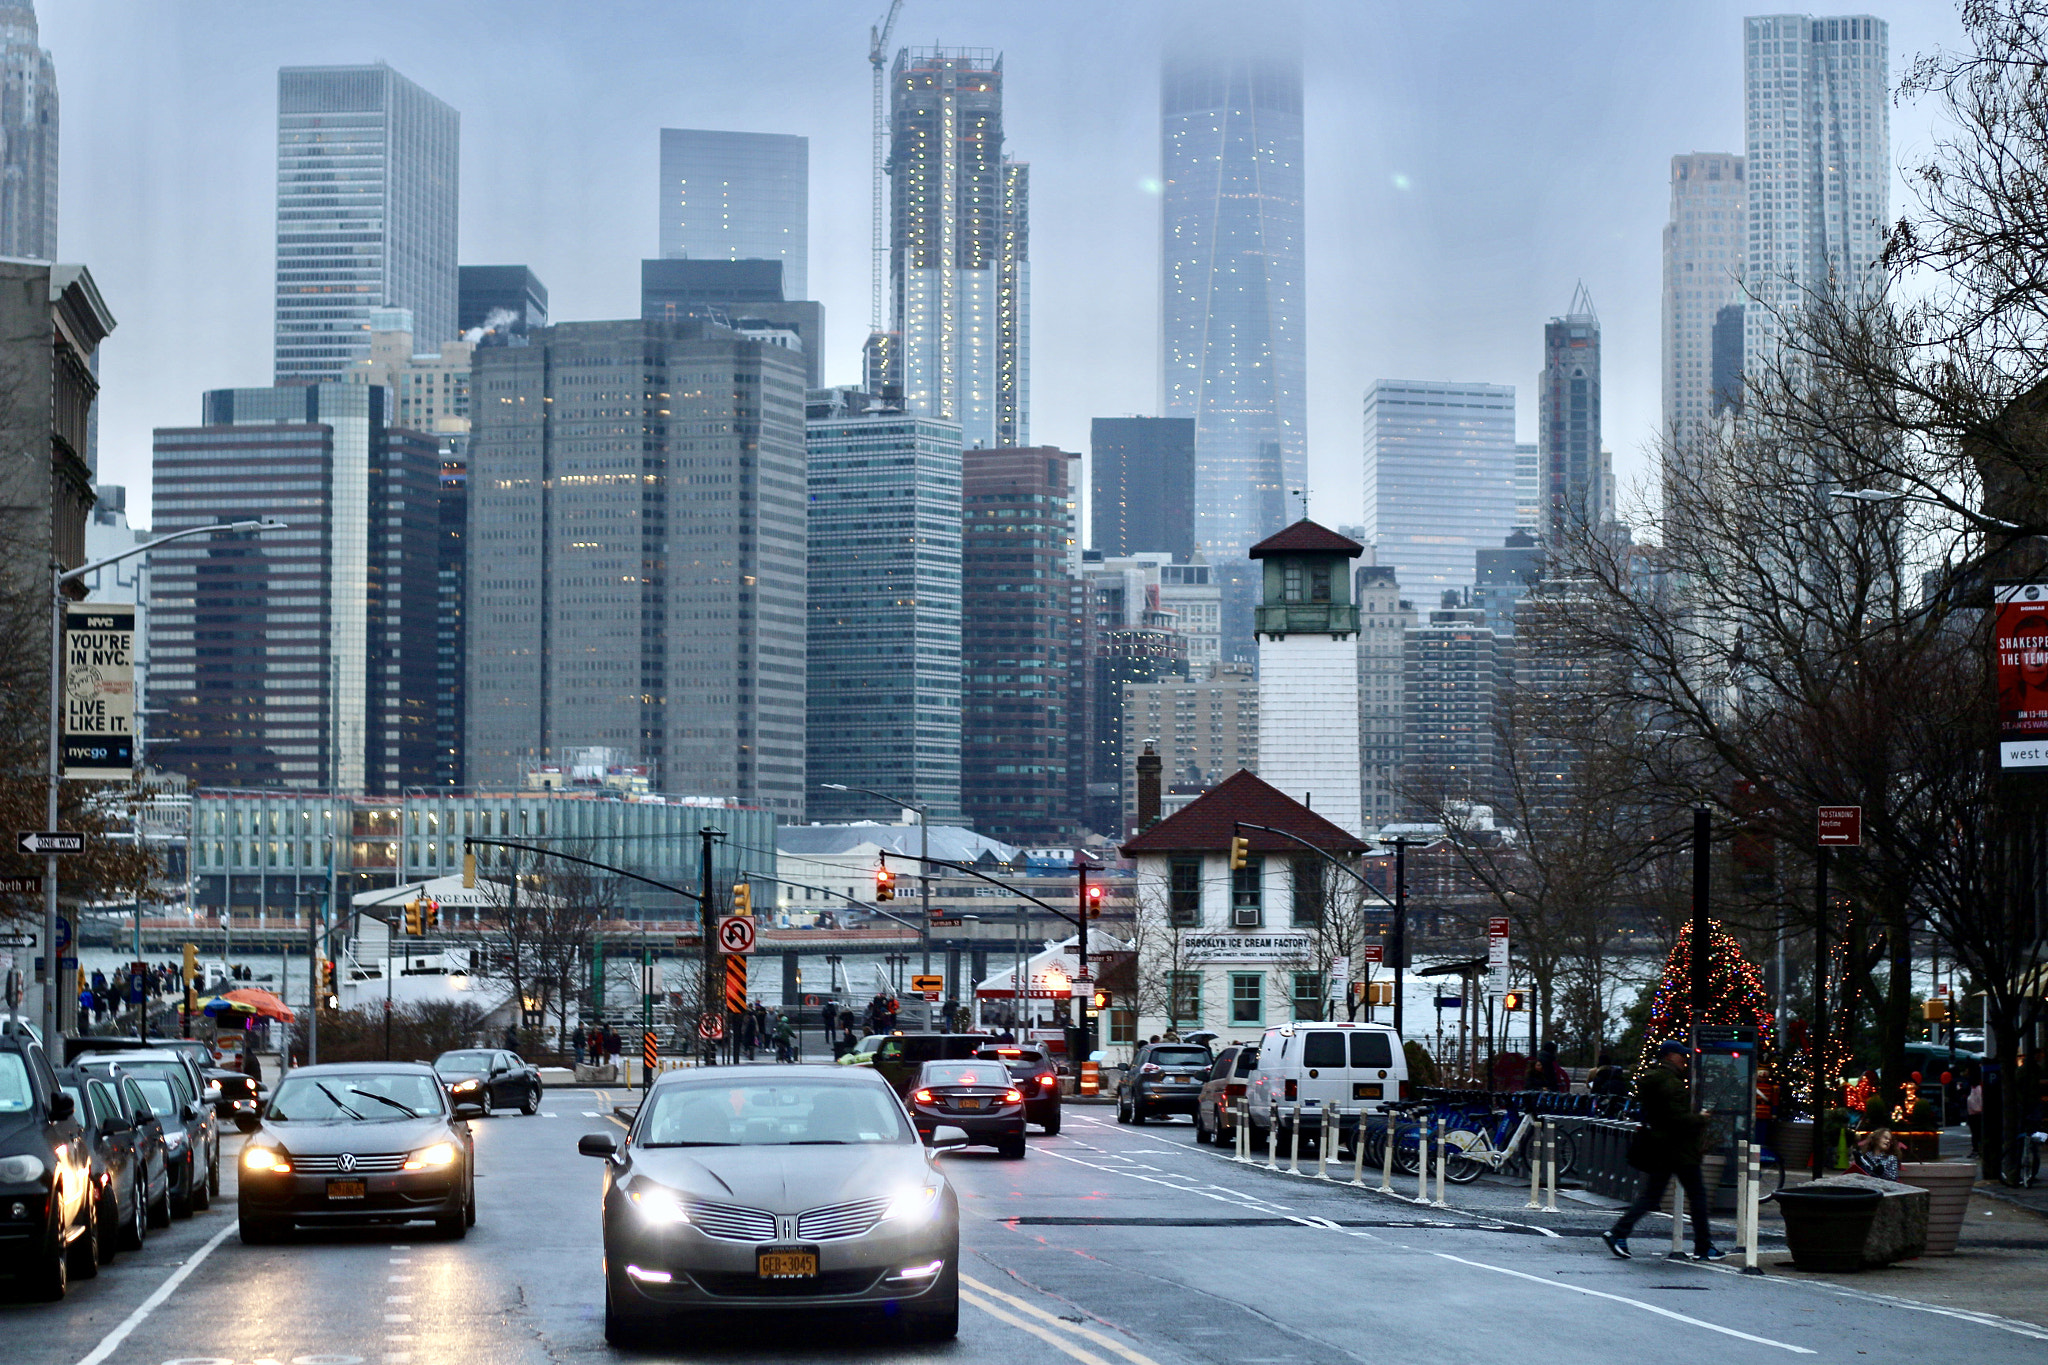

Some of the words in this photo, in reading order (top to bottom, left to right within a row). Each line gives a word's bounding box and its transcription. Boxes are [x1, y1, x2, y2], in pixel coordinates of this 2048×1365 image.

[87, 616, 114, 627] NYC
[70, 633, 131, 650] YOU'RE
[70, 650, 87, 666] IN
[92, 650, 130, 666] NYC.
[2001, 653, 2020, 666] THE
[69, 699, 106, 716] LIVE
[69, 716, 106, 732] LIKE
[110, 716, 128, 732] IT.
[68, 746, 108, 760] nycgo
[2010, 748, 2040, 760] west
[1820, 810, 1829, 818] NO
[1829, 810, 1854, 818] STANDING
[37, 838, 55, 848] ONE
[58, 838, 78, 848] WAY
[26, 879, 35, 891] Pl
[1185, 938, 1226, 948] BROOKLYN
[1229, 938, 1241, 948] ICE
[1244, 938, 1272, 948] CREAM
[1274, 938, 1308, 948] FACTORY
